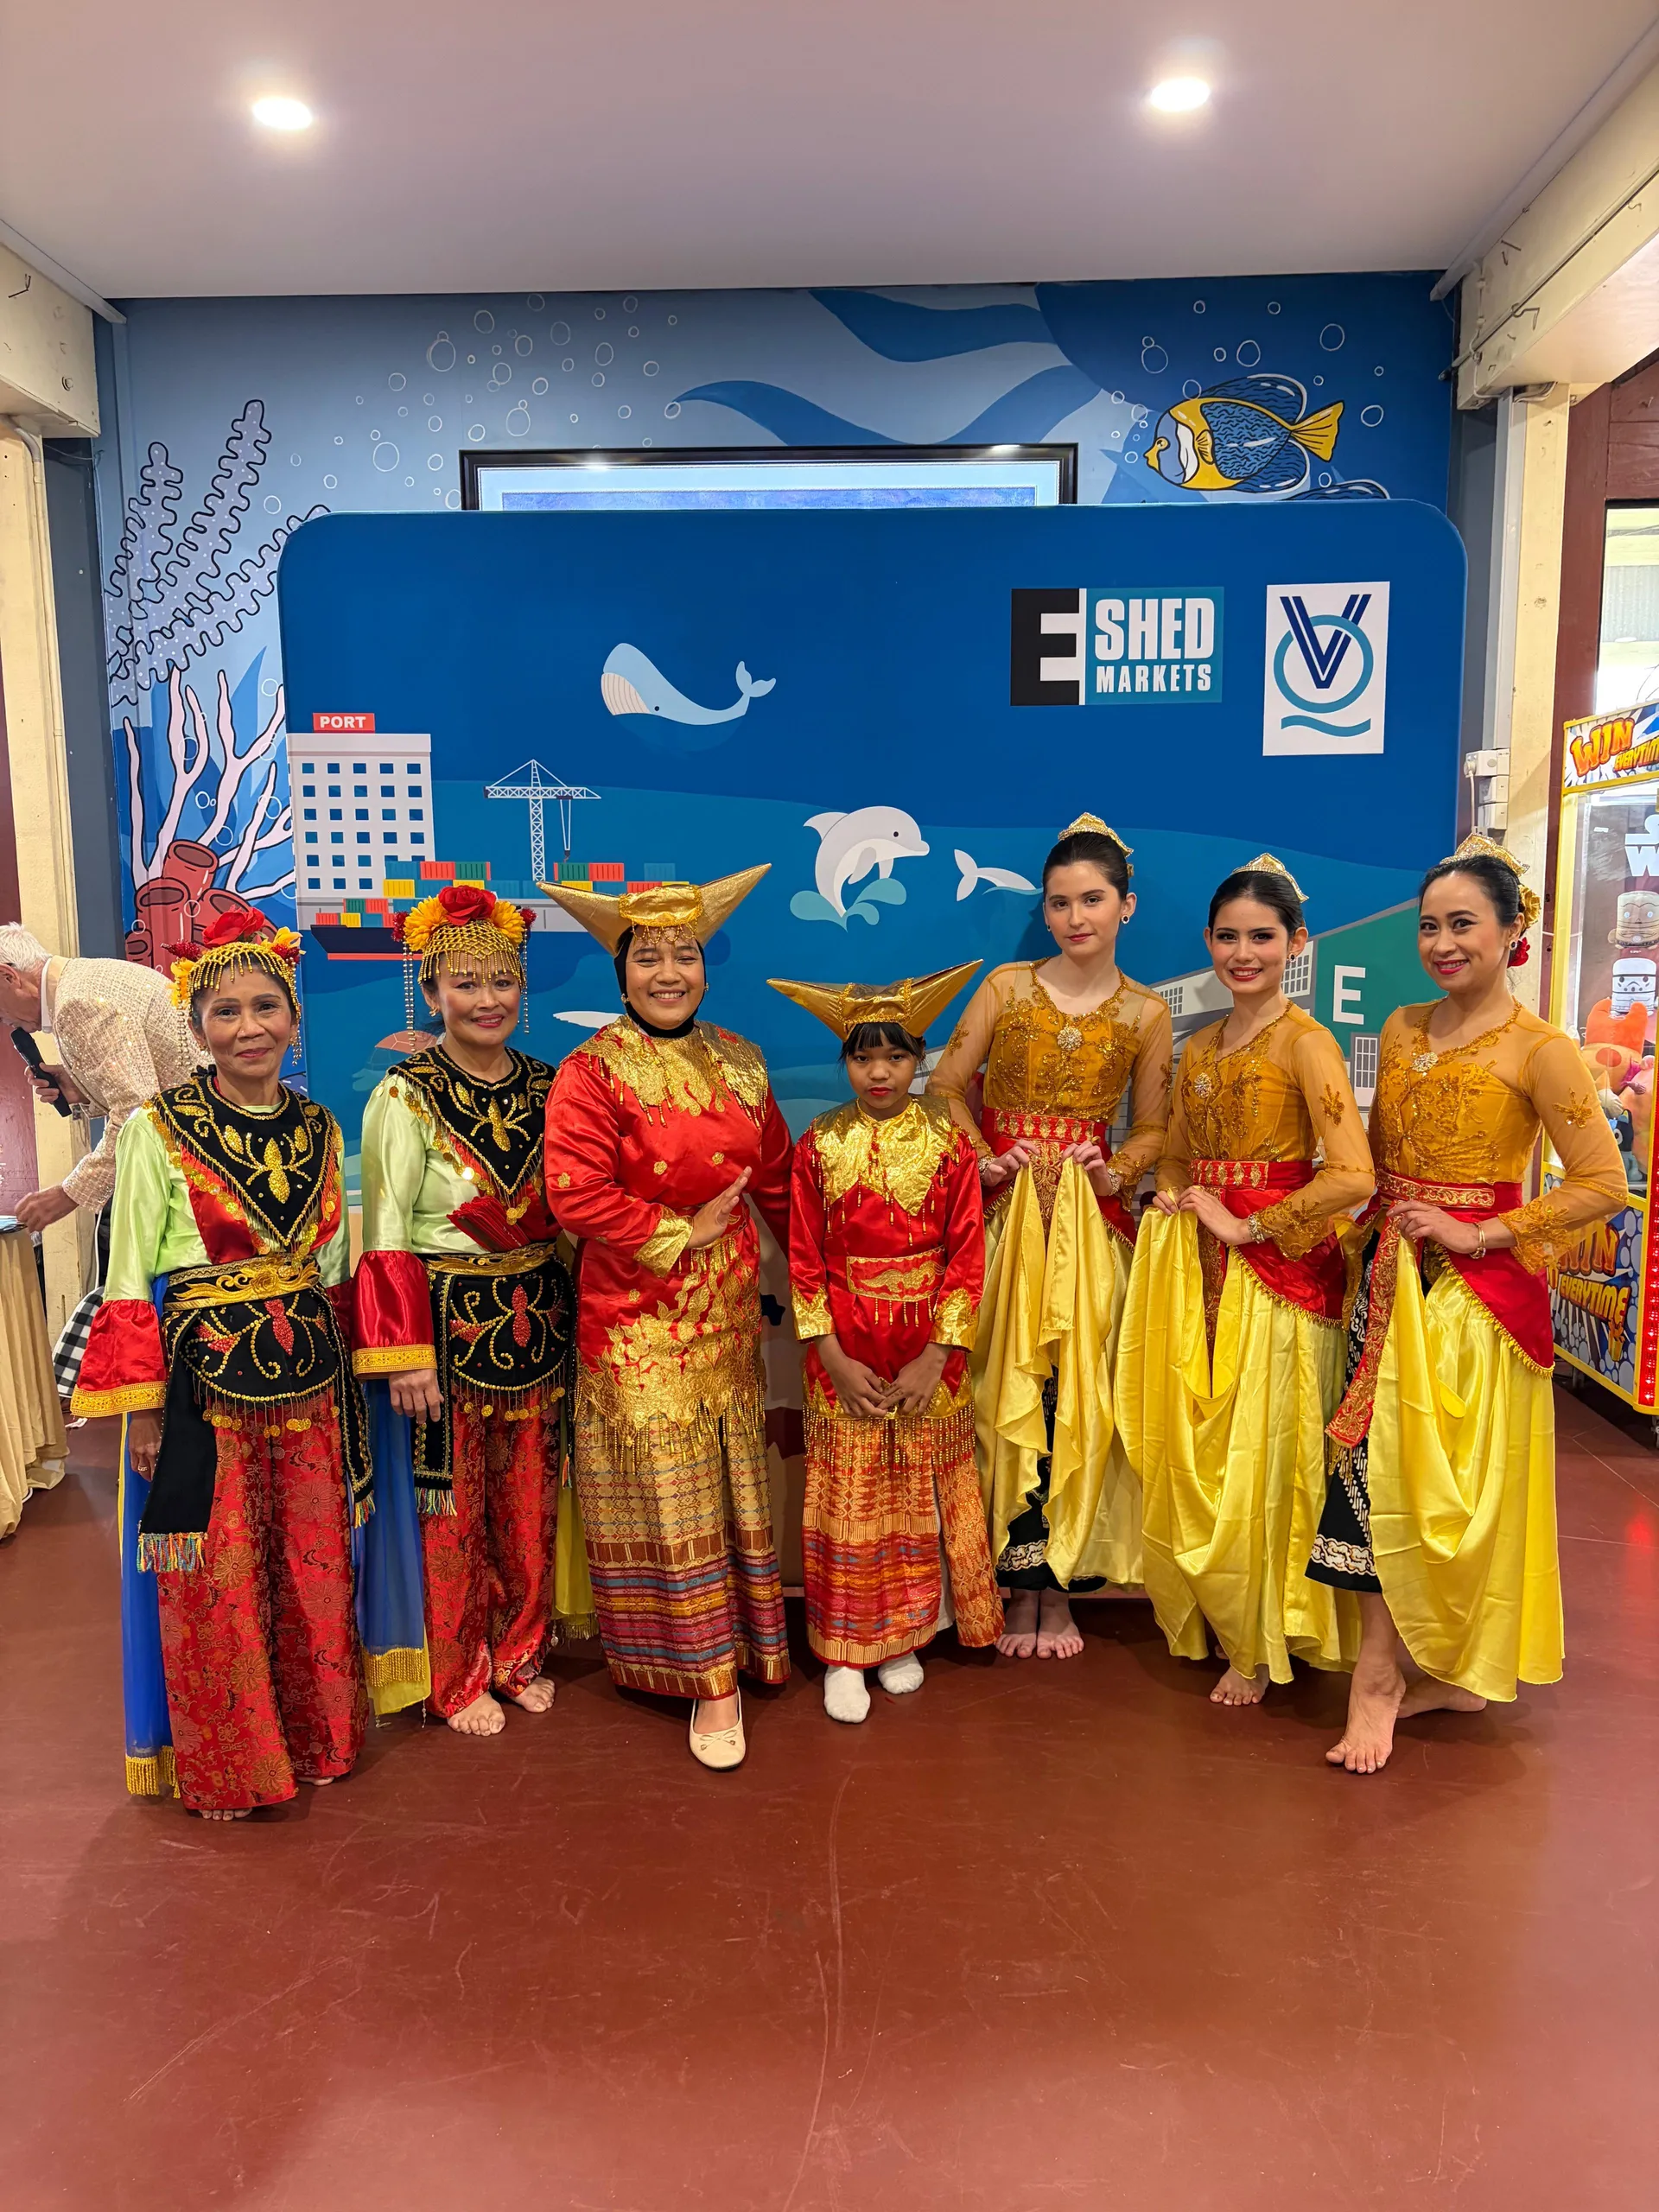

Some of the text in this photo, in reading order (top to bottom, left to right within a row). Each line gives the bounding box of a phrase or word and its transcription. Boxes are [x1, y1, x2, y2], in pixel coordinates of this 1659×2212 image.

[1010, 588, 1215, 706] E SHED
[1096, 664, 1211, 692] MARKETS
[320, 715, 366, 728] PORT
[1571, 718, 1635, 777] WIN
[1332, 964, 1366, 1026] E
[1560, 1275, 1630, 1326] EVERYTIME
